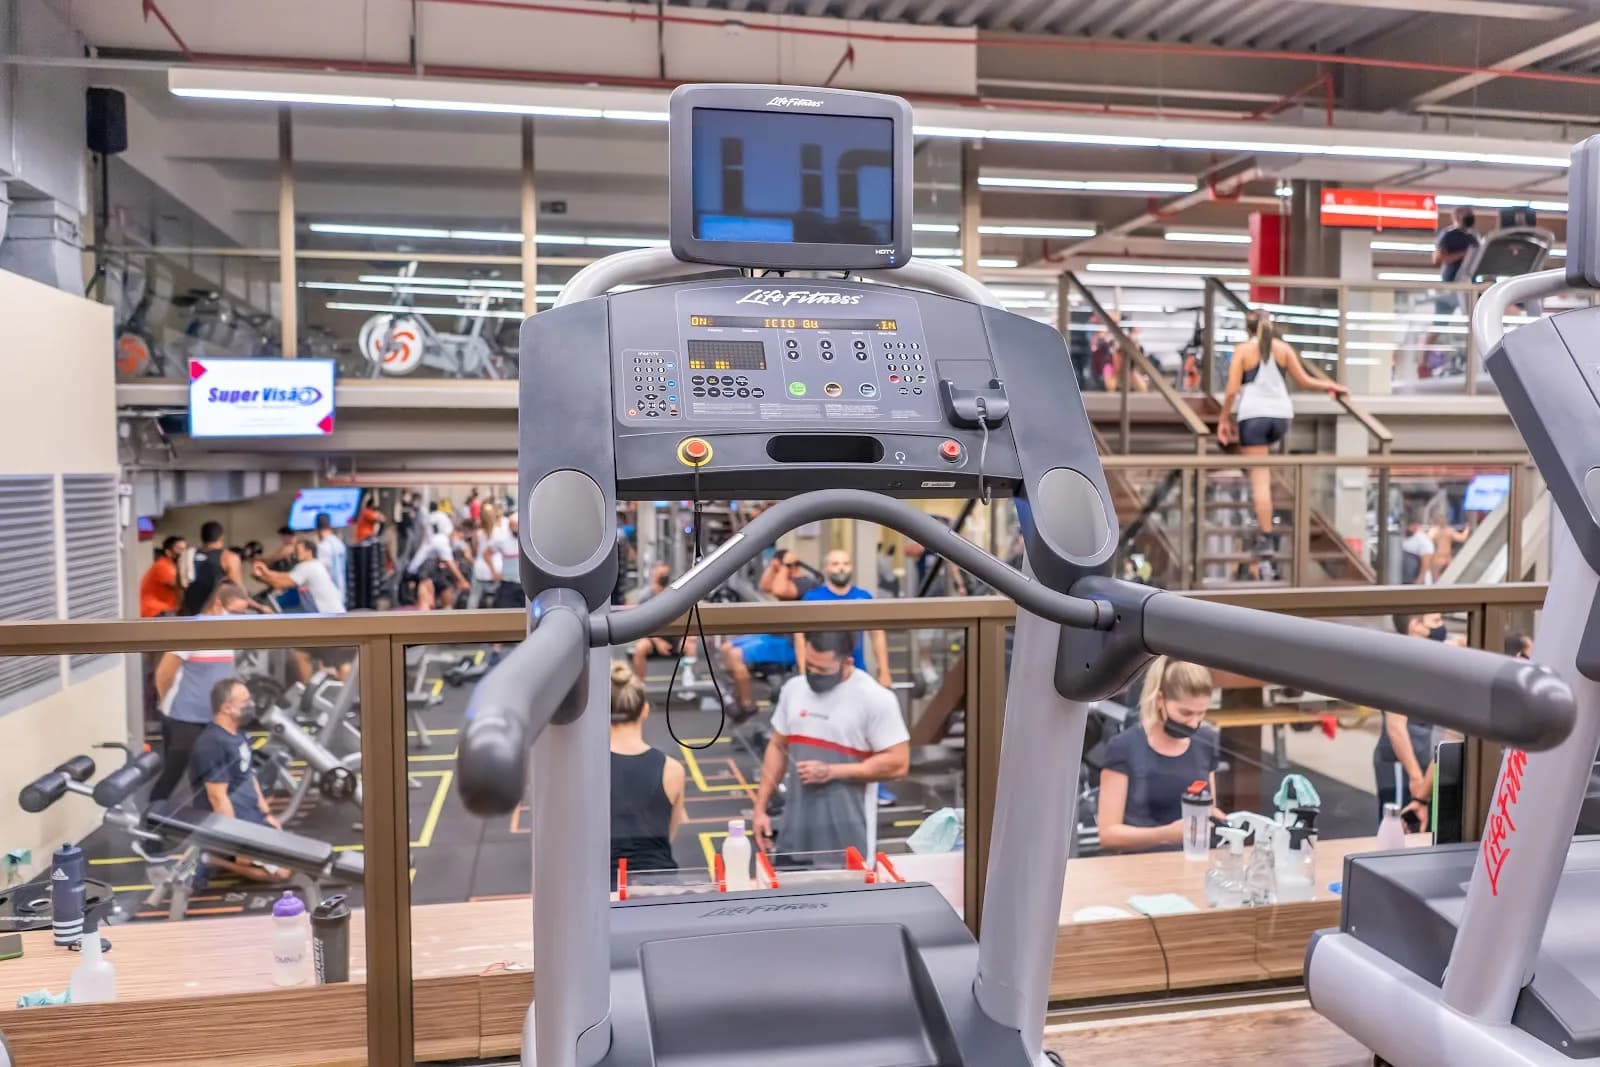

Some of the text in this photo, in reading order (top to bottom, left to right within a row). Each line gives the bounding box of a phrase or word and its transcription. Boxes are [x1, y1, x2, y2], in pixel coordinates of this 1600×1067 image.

[735, 288, 860, 306] Life Fitness
[208, 387, 260, 404] Super
